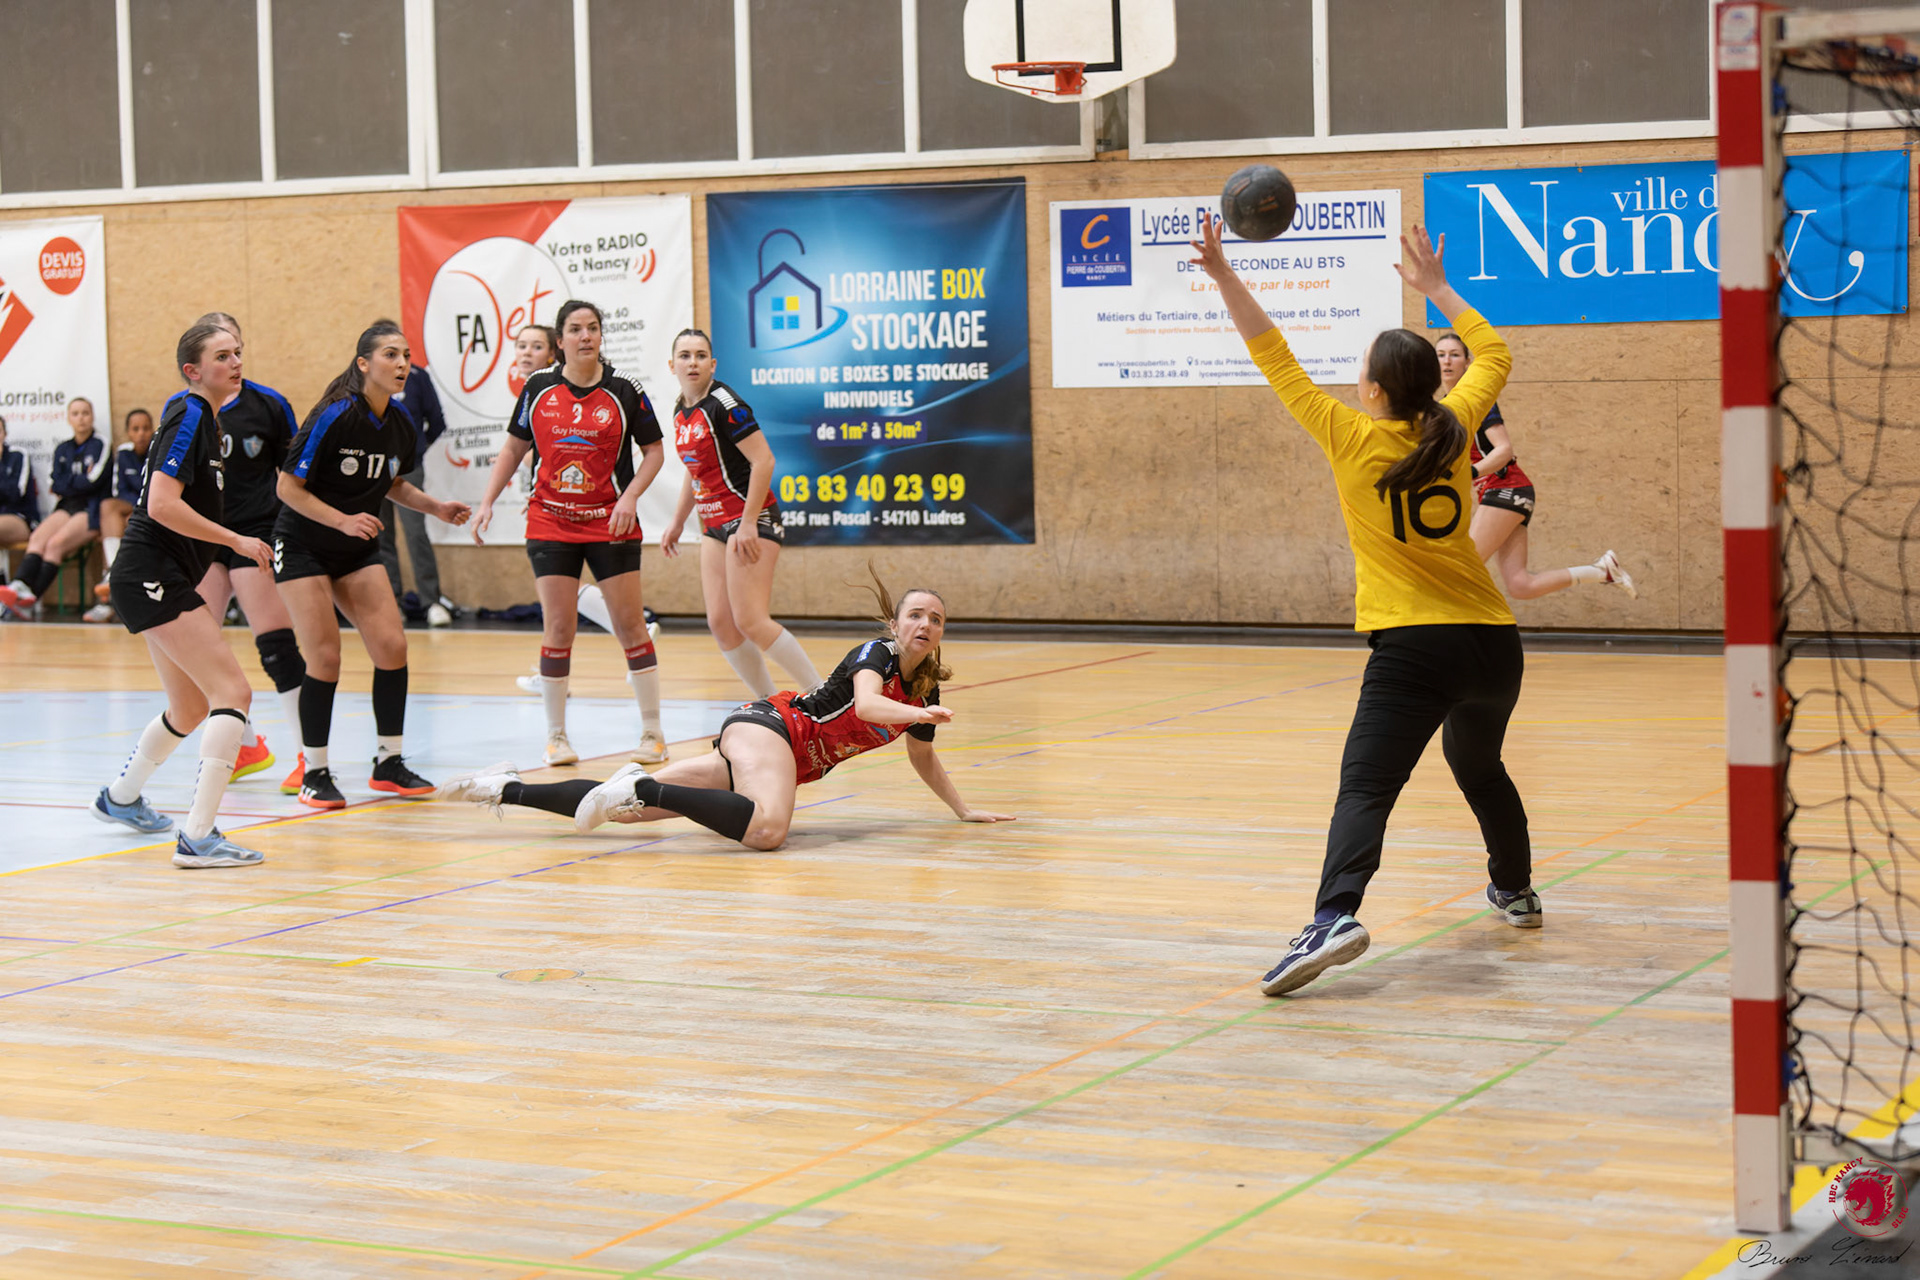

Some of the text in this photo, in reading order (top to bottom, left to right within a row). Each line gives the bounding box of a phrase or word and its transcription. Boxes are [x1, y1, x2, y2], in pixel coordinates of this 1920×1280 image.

[1612, 174, 1718, 213] ville d
[1141, 207, 1190, 242] Lycée
[1291, 201, 1386, 231] OUBERTIN
[1081, 214, 1111, 249] C
[548, 232, 647, 257] Votre RADIO
[41, 251, 83, 268] DEVIS
[568, 256, 630, 272] à Nancy
[1072, 253, 1120, 262] LYCÉE
[1177, 260, 1195, 272] DE
[1228, 257, 1289, 271] ECONDE
[1293, 257, 1313, 269] AU
[1317, 256, 1345, 269] BTS
[43, 267, 83, 280] GRATUIT
[1066, 264, 1126, 274] PIERRE de COUBERTIN
[829, 267, 986, 302] LORRAINE BOX
[1190, 281, 1205, 292] La
[1260, 280, 1280, 292] par
[1284, 278, 1294, 290] le
[1297, 278, 1331, 291] sport
[614, 307, 629, 318] 60
[1097, 311, 1135, 322] Métiers
[1138, 311, 1151, 321] du
[1155, 310, 1202, 321] Tertiaire,
[1204, 309, 1217, 320] de
[1299, 309, 1310, 318] et
[1312, 308, 1327, 317] du
[1329, 307, 1360, 320] Sport
[601, 320, 645, 335] SSIONS
[850, 310, 989, 351] STOCKAGE
[1125, 327, 1157, 335] Sections
[1158, 327, 1192, 335] sportives
[1225, 358, 1253, 366] Préside
[1329, 356, 1357, 364] NANCY
[751, 362, 989, 385] LOCATION DE BOXES DE STOCKAGE
[823, 389, 914, 409] INDIVIDUELS
[446, 423, 503, 441] ogrammes
[551, 425, 599, 437] Guy Hoquet
[816, 422, 836, 440] de
[871, 421, 882, 440] à
[367, 453, 386, 479] 17
[780, 473, 965, 503] 03 83 40 23 99
[1390, 470, 1462, 544] 16
[781, 510, 806, 526] 256
[809, 512, 830, 526] rue
[833, 510, 871, 526] Pascal
[881, 510, 920, 526] 54710
[923, 509, 966, 526] Ludres
